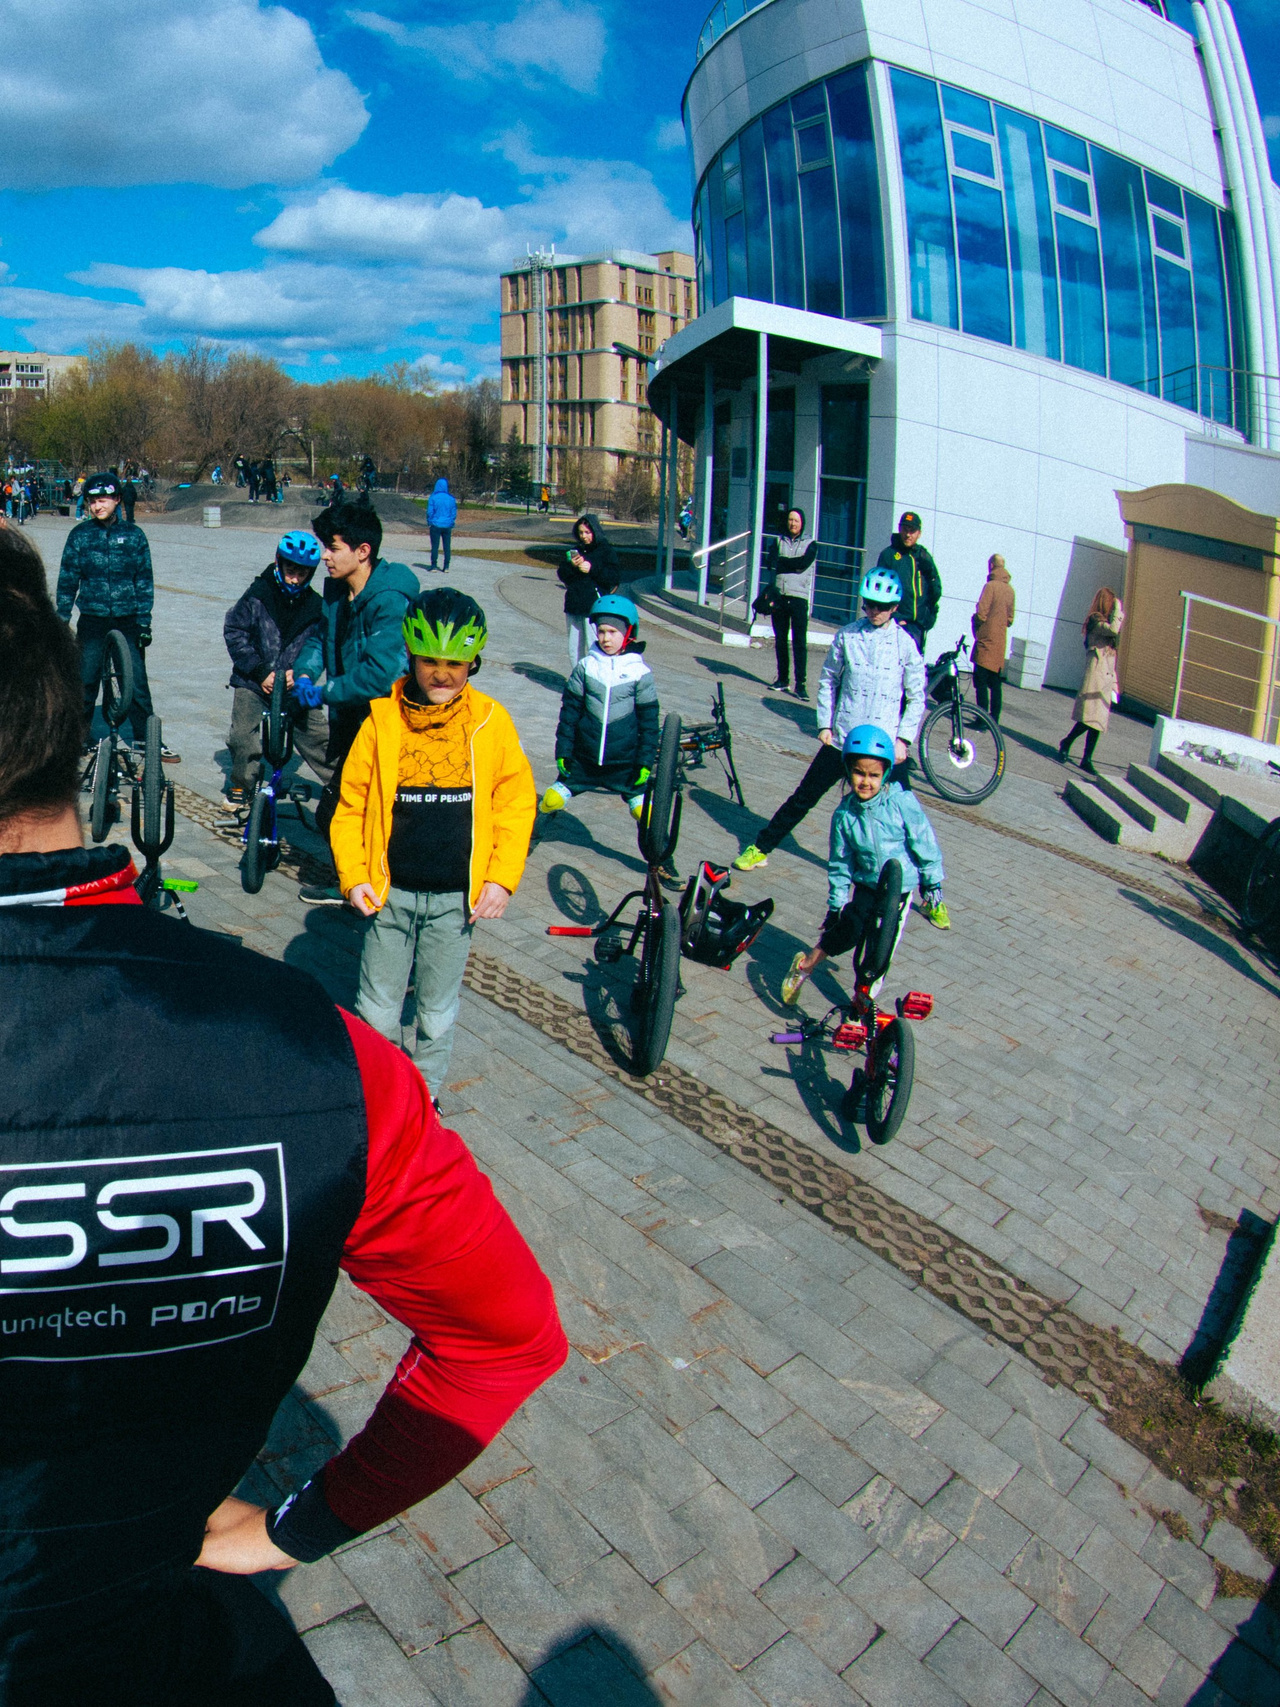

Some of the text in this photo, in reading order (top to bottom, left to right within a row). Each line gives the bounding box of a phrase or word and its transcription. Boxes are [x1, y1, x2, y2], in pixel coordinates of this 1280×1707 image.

[400, 793, 422, 803] TIME
[424, 793, 438, 803] OF
[1, 1303, 127, 1338] uniqtech
